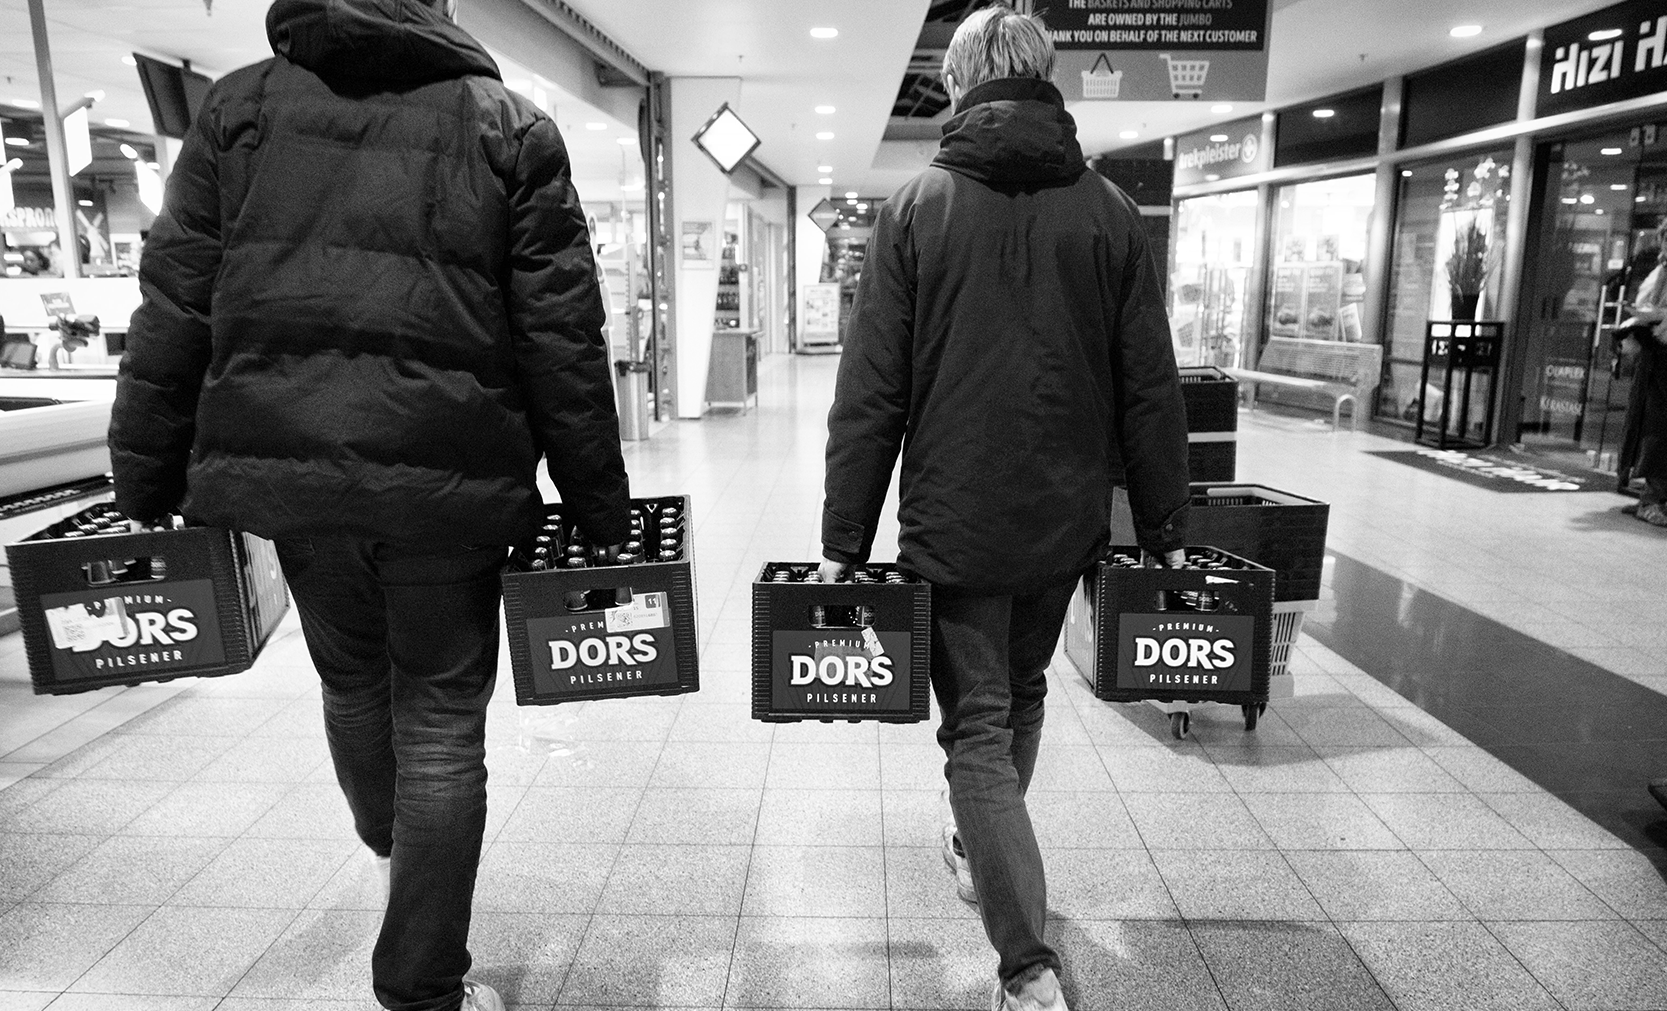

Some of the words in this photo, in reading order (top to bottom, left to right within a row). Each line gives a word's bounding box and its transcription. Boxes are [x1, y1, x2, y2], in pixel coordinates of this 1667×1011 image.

[1068, 0, 1086, 9] THE
[1087, 0, 1129, 9] BASKETS
[1130, 0, 1150, 9] AND
[1151, 0, 1202, 9] SHOPPING
[1203, 0, 1233, 9] CARTS
[1087, 13, 1107, 26] ARE
[1108, 13, 1144, 26] OWNED
[1145, 13, 1159, 26] BY
[1159, 13, 1178, 26] THE
[1178, 13, 1212, 27] JUMBO
[1073, 30, 1093, 42] YOU
[1094, 30, 1109, 42] ON
[1109, 30, 1145, 42] BEHALF
[1146, 30, 1160, 42] OF
[1160, 30, 1179, 42] THE
[1180, 30, 1205, 42] NEXT
[1205, 30, 1258, 42] CUSTOMER
[1550, 40, 1624, 94] HIZI
[1634, 15, 1667, 72] H
[548, 633, 658, 670] DORS
[1134, 637, 1235, 670] DORS
[95, 650, 183, 669] PILSENER
[570, 670, 643, 685] PILSENER
[791, 655, 893, 688] DORS
[1150, 674, 1218, 685] PILSENER
[807, 693, 877, 704] PILSENER
